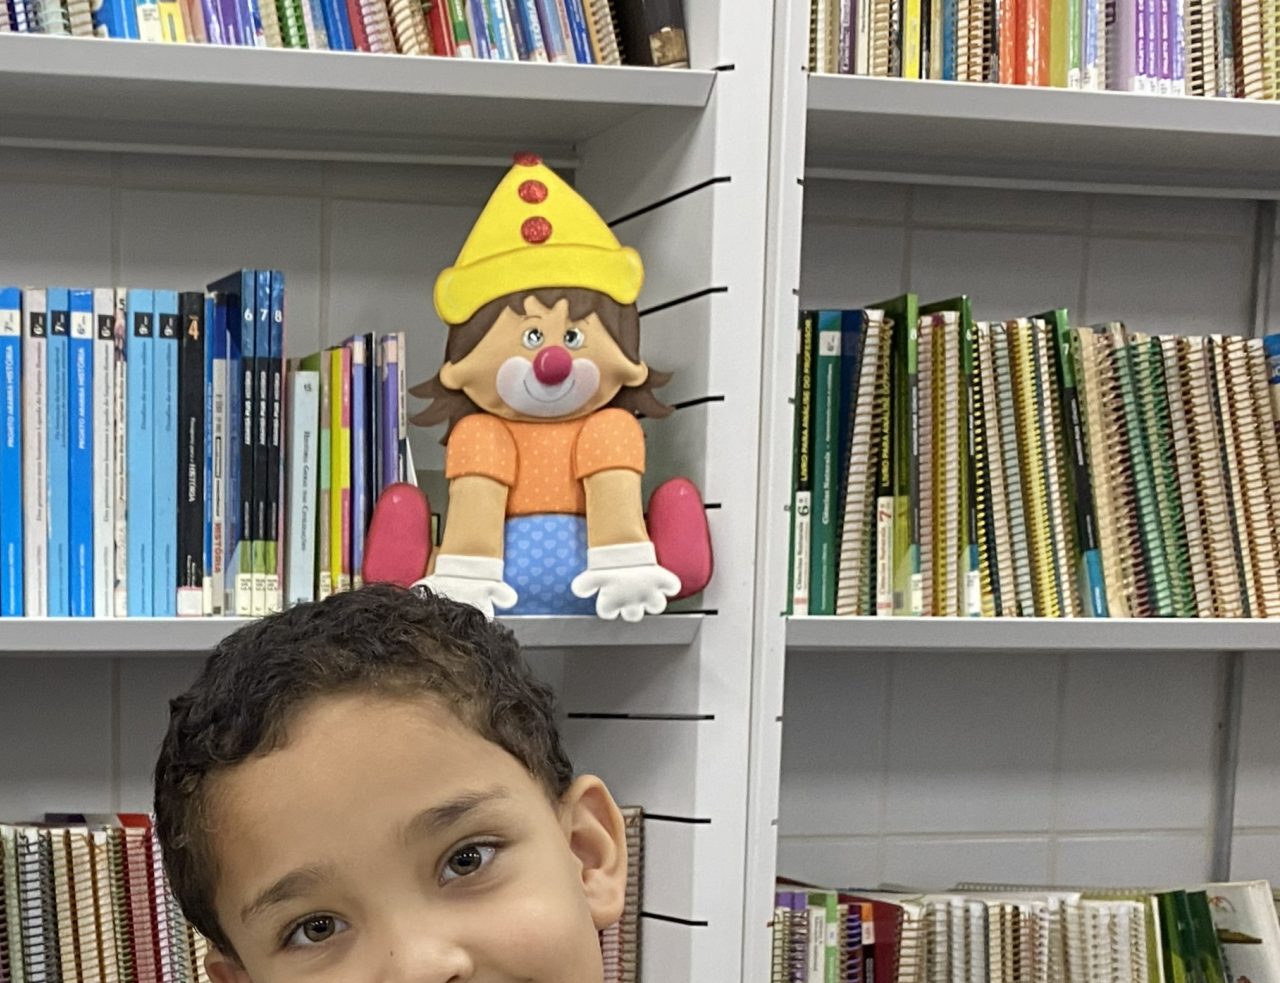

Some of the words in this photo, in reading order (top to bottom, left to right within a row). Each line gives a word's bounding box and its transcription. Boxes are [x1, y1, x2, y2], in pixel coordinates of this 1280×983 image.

[244, 309, 254, 322] 6
[259, 309, 269, 322] 7
[803, 319, 812, 374] PROFESSOR
[3, 344, 14, 383] HISTÓRIA
[75, 347, 86, 386] HISTÓRIA
[803, 375, 810, 388] DO
[801, 390, 810, 429] ANÁLISE
[6, 416, 15, 448] PROJETO
[77, 418, 86, 449] PROJETO
[822, 452, 831, 488] Naturais
[881, 461, 889, 486] LIVRO
[822, 490, 830, 525] Ciências
